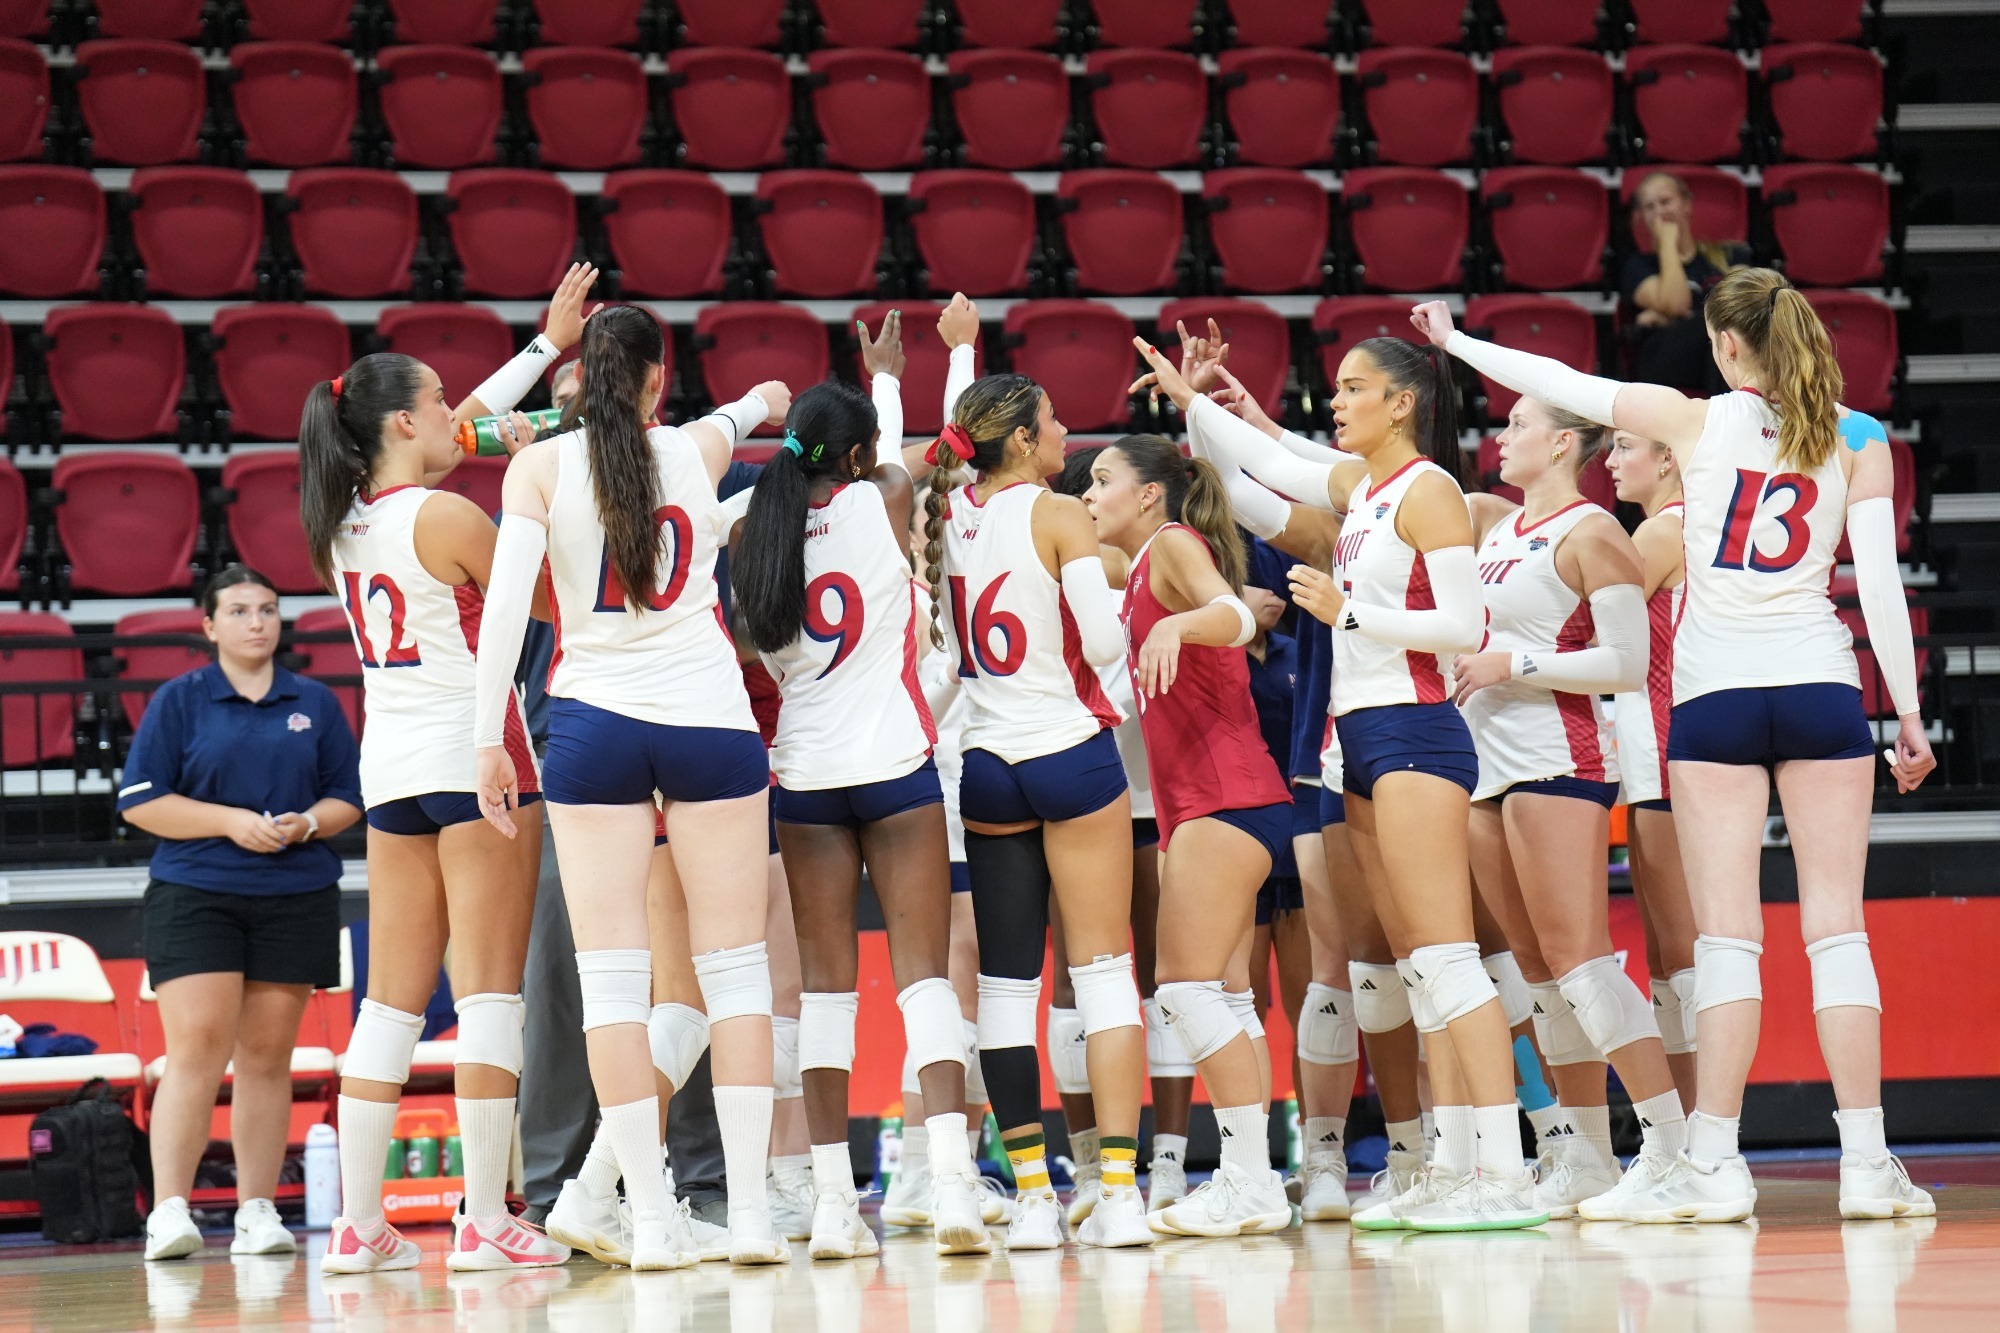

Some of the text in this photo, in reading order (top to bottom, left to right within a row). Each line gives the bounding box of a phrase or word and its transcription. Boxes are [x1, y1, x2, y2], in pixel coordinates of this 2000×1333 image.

[1333, 529, 1371, 573] NJIT
[1711, 468, 1818, 573] 13
[340, 571, 423, 668] 12
[802, 571, 864, 680] 9
[948, 571, 1027, 678] 16
